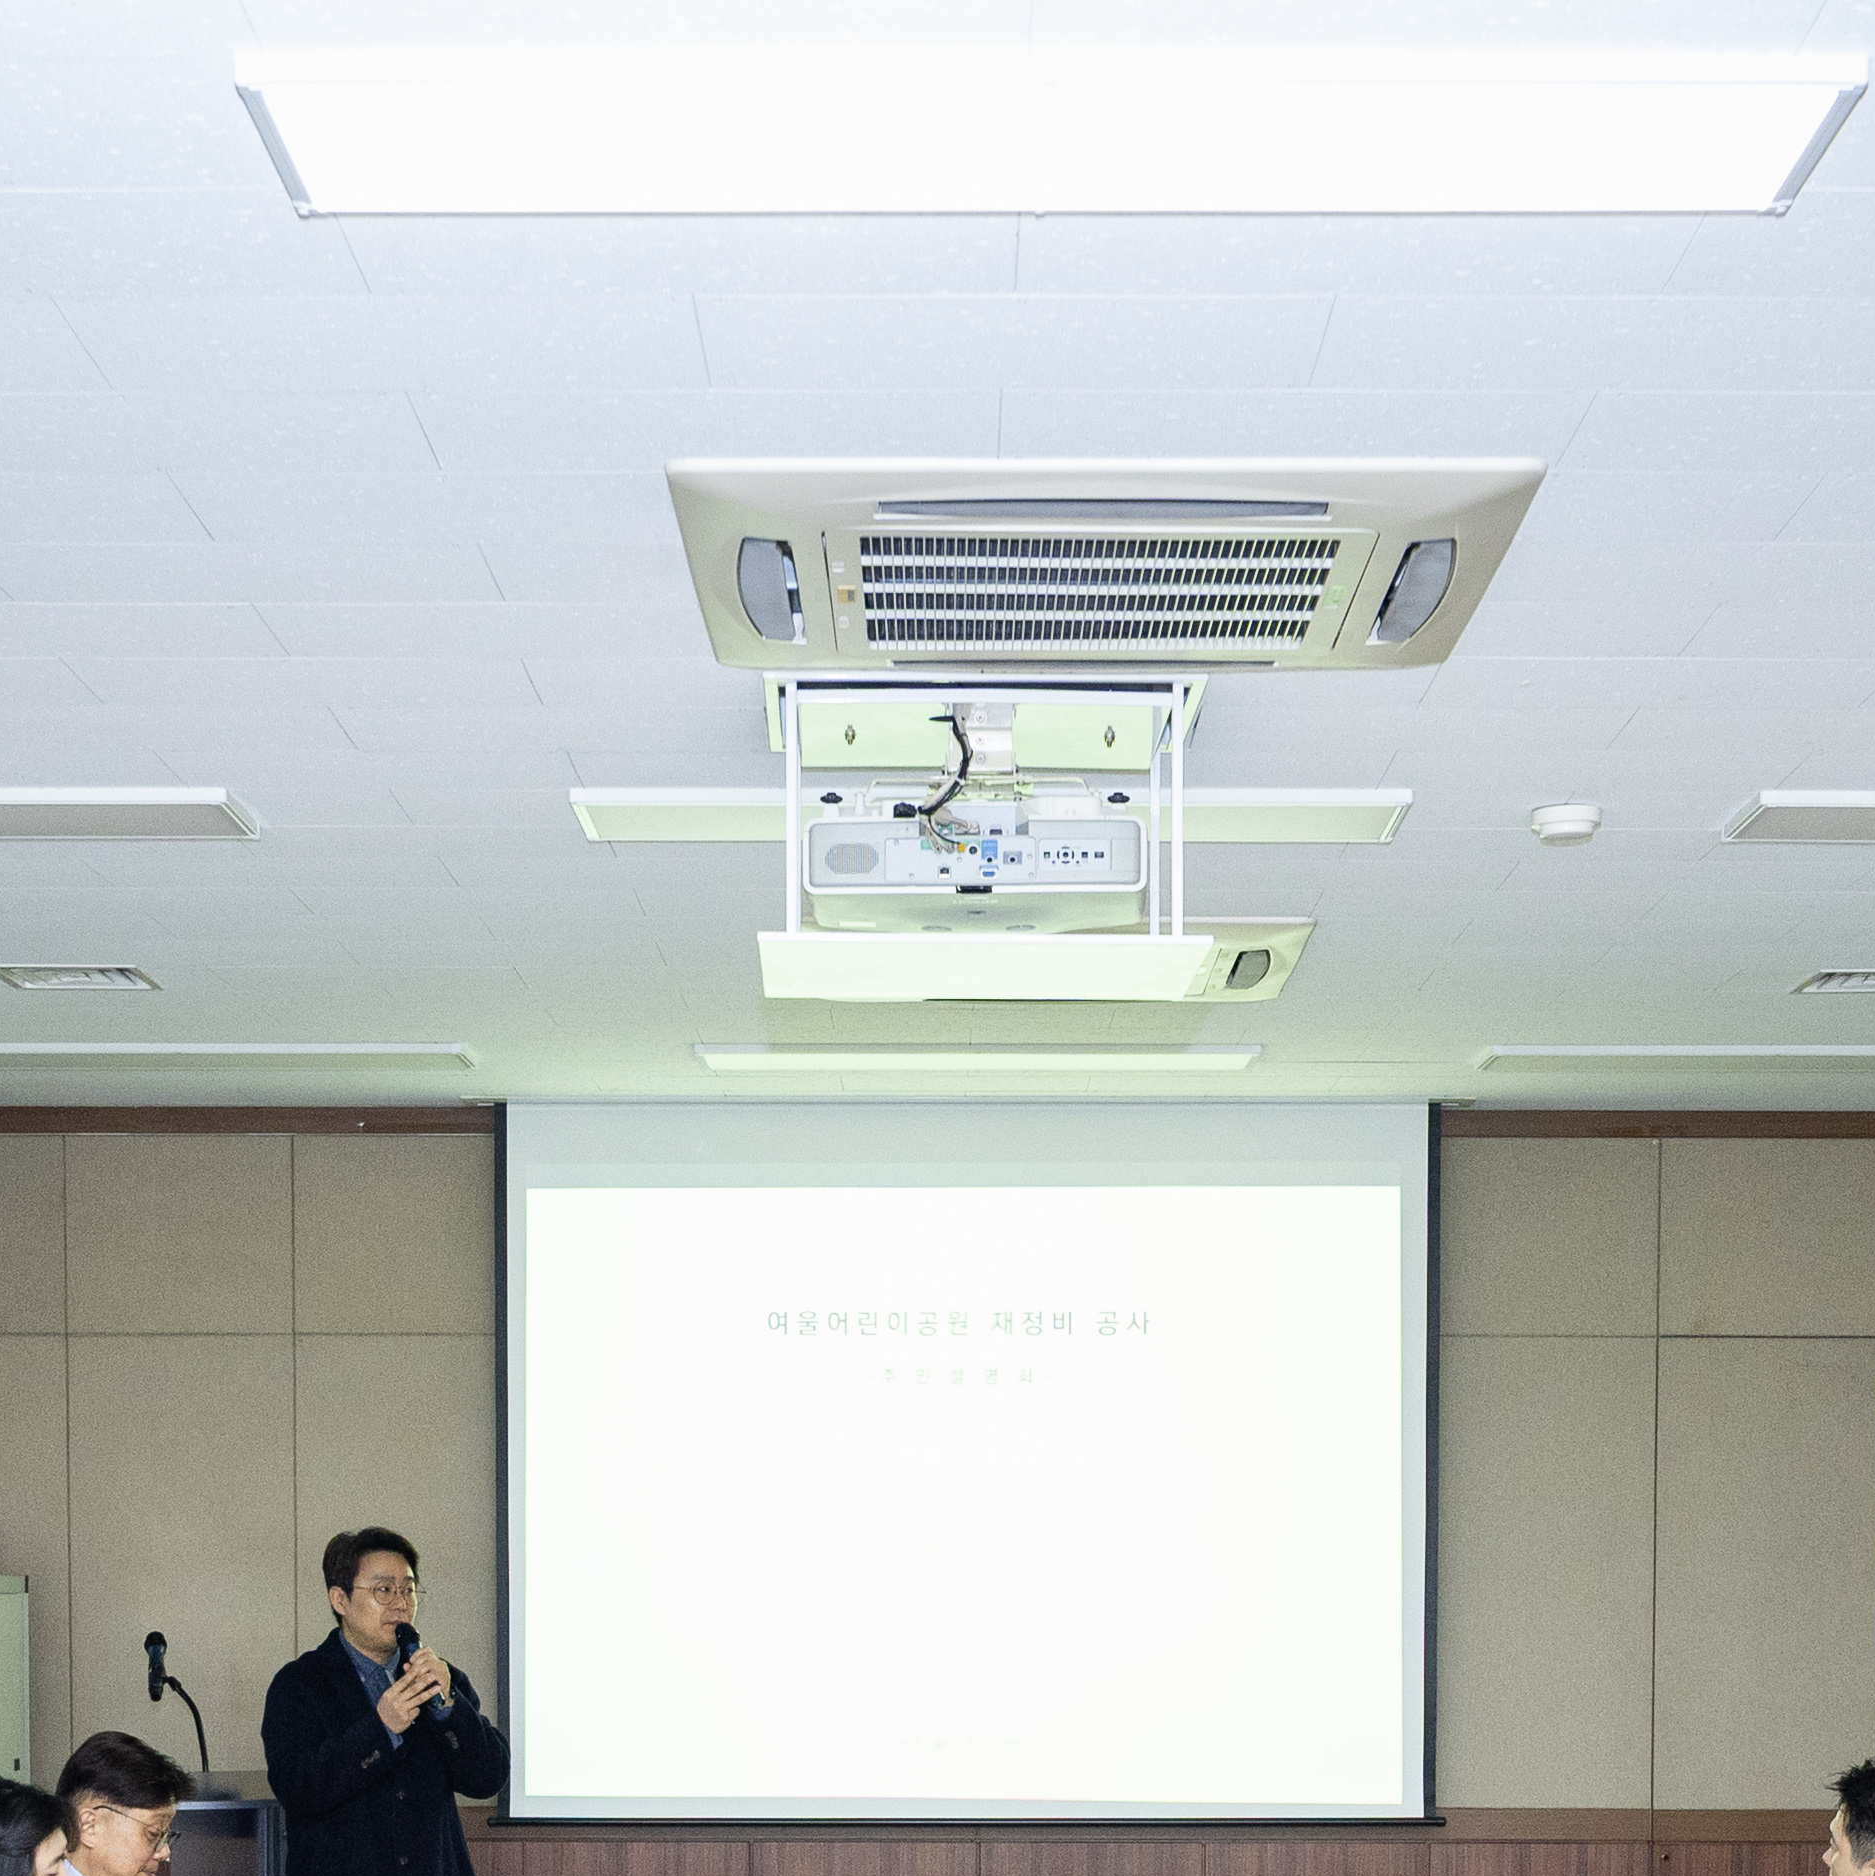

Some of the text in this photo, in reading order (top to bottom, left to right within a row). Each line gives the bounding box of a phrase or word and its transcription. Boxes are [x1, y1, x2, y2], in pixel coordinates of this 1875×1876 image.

[766, 1310, 1151, 1337] 여울어린이공원 재정비 공사
